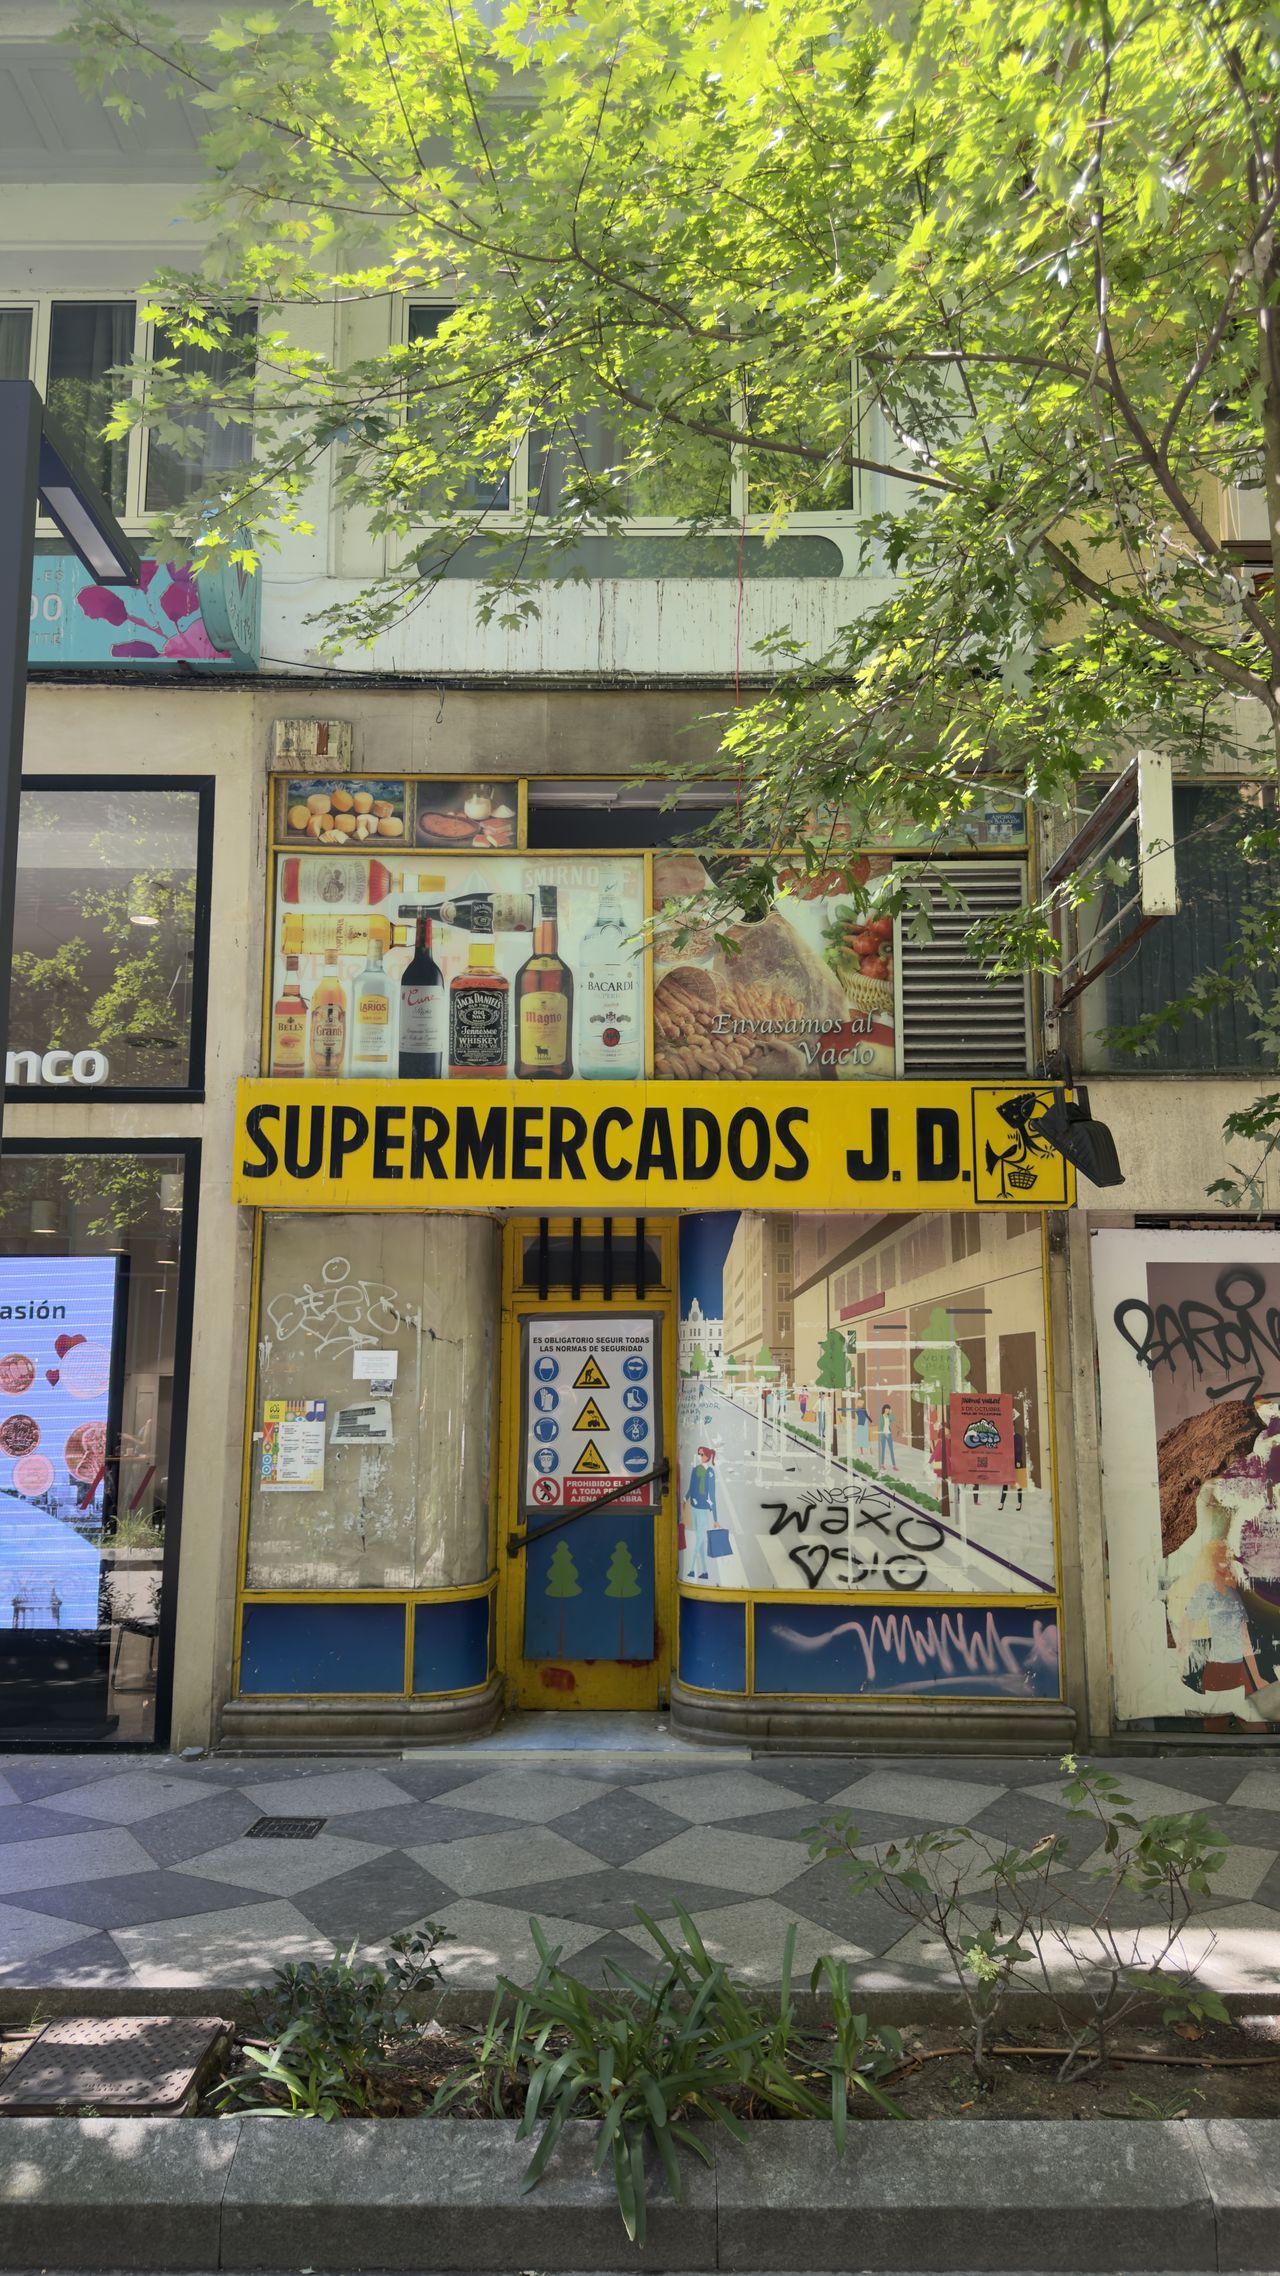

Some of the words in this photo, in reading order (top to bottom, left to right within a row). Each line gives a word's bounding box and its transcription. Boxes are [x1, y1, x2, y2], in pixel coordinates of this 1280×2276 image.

[526, 1011, 562, 1025] Magno
[711, 1014, 842, 1035] Envasamos
[851, 1008, 878, 1033] al
[800, 1042, 874, 1065] Vacío
[242, 1104, 809, 1181] SUPERMERCADOS
[846, 1107, 971, 1182] J.D.
[0, 1300, 66, 1319] asión
